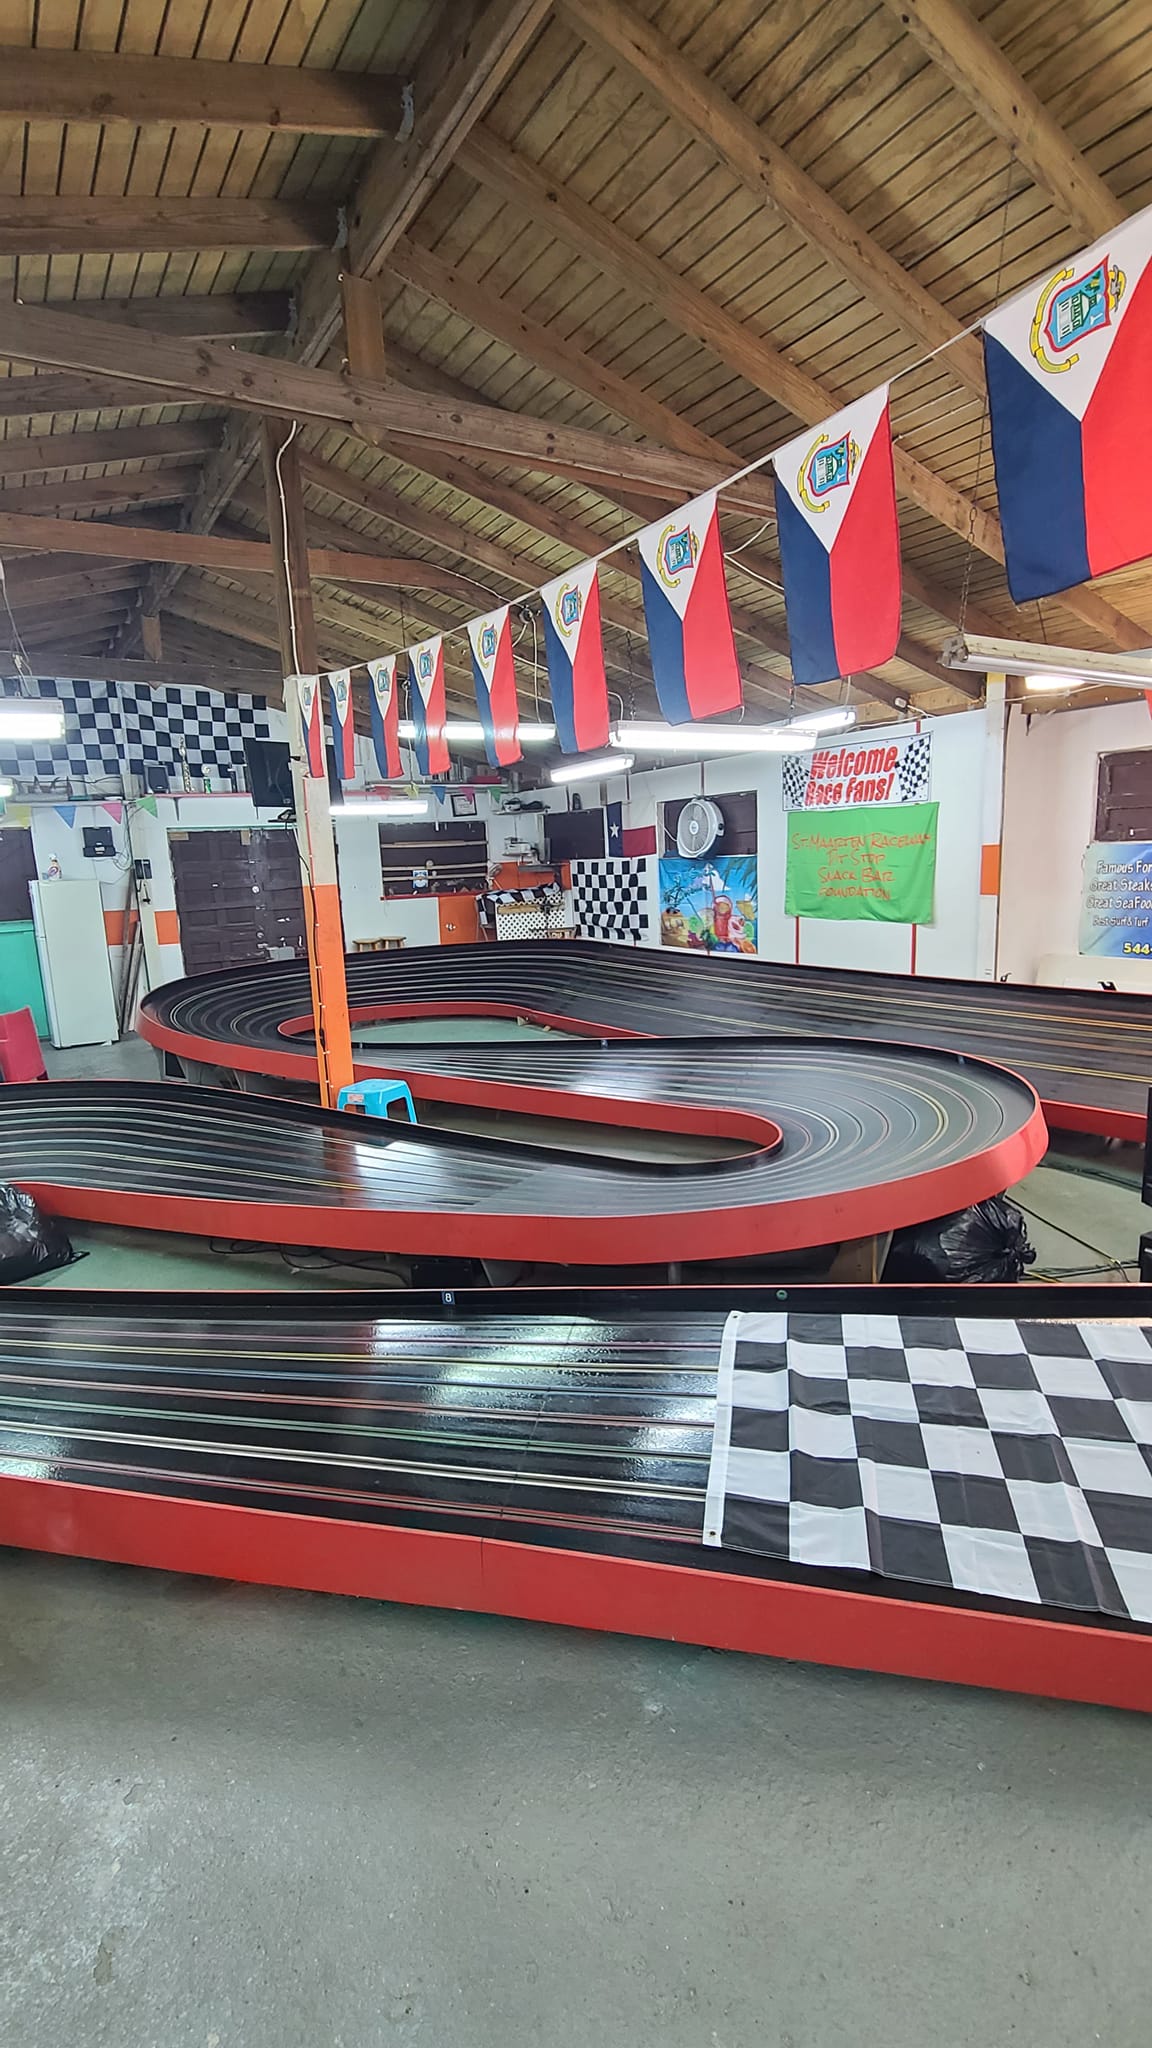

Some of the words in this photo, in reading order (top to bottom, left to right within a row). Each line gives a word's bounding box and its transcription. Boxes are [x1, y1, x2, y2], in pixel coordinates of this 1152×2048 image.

[809, 746, 898, 780] Welcome
[804, 781, 843, 806] Race
[845, 772, 895, 803] Fans!
[861, 866, 896, 883] BAR
[1096, 860, 1133, 874] Famous
[1136, 860, 1152, 874] For
[1090, 878, 1118, 892] Great
[819, 886, 891, 901] FOUNDATION
[1086, 895, 1114, 909] Great
